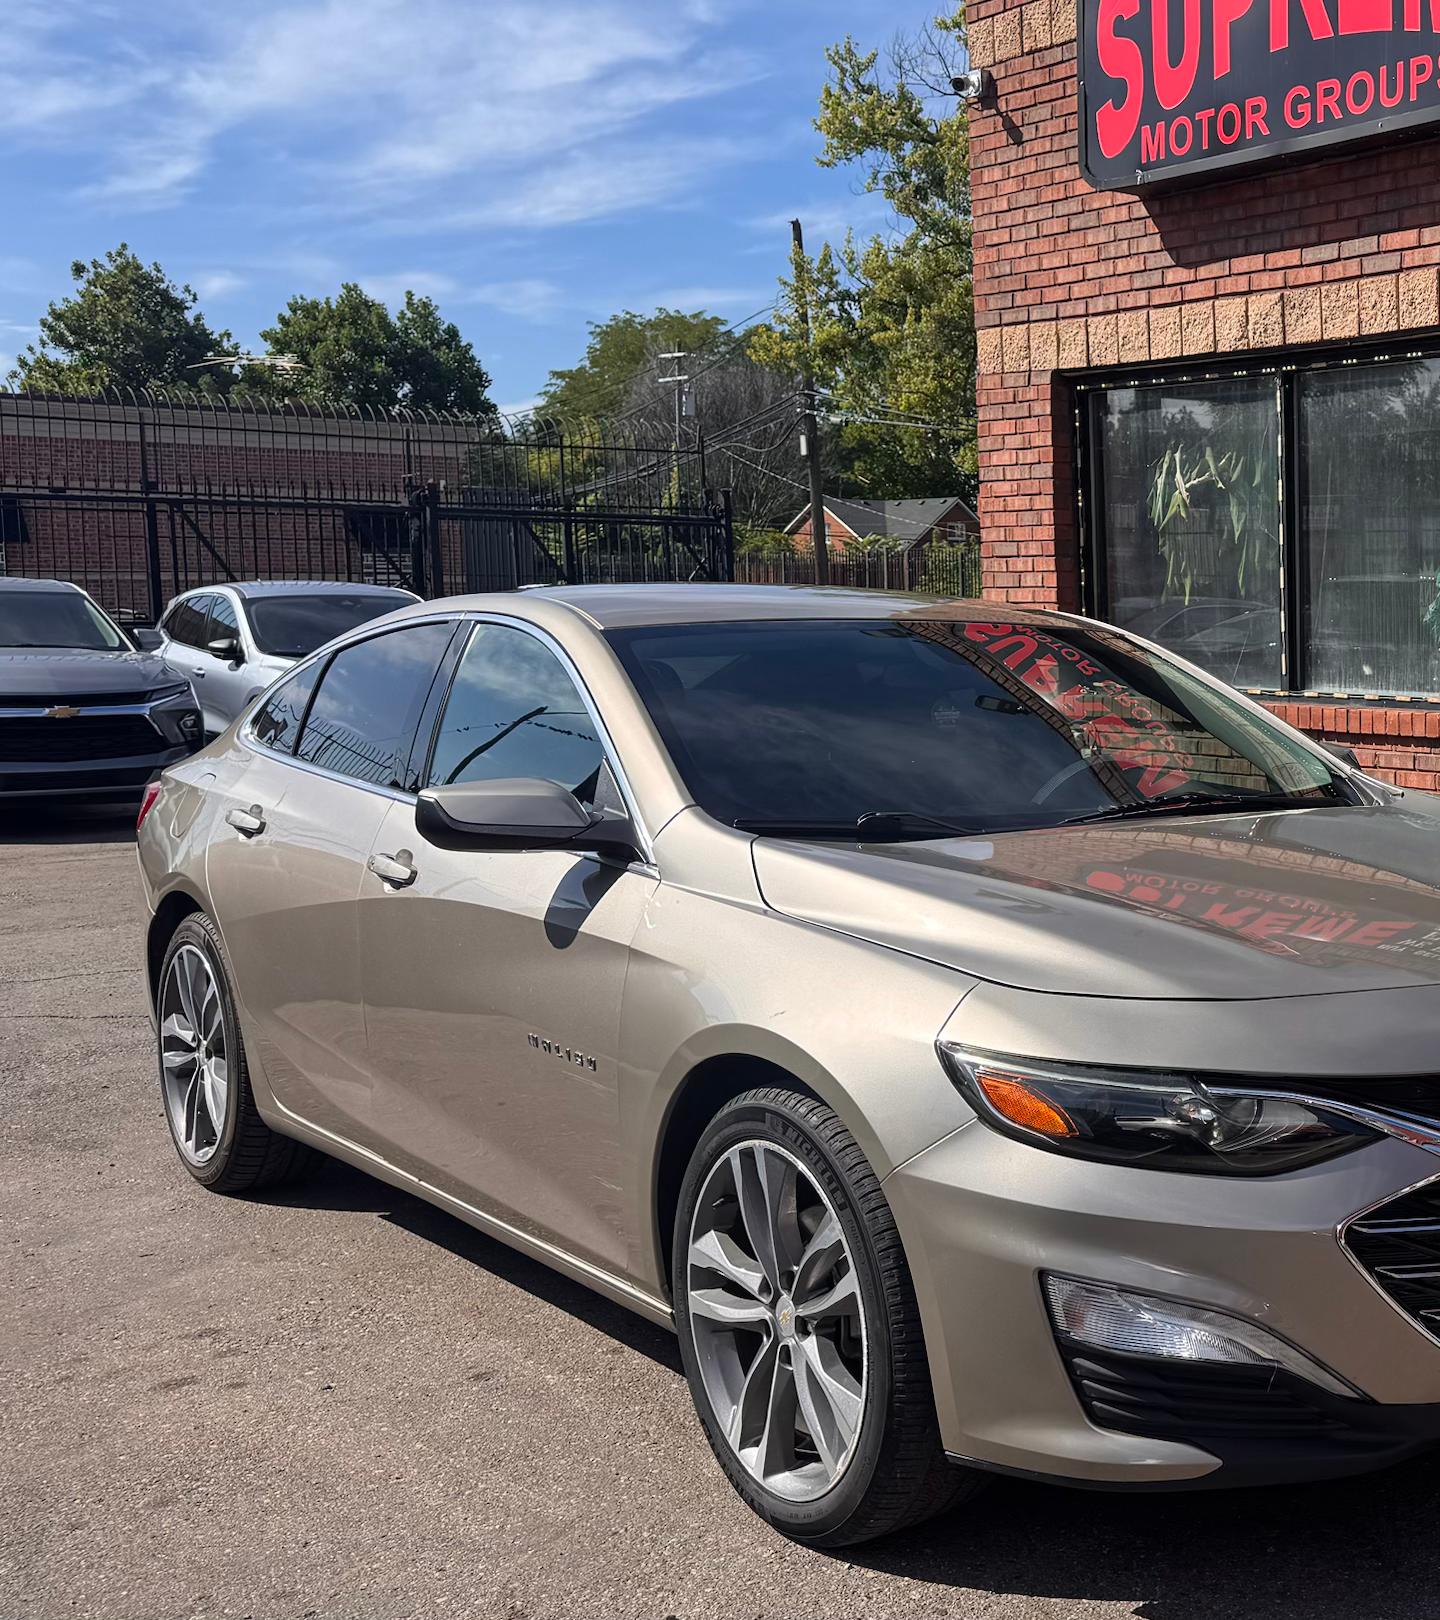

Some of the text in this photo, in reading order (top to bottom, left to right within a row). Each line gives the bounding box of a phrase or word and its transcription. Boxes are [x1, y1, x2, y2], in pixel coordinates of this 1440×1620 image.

[1141, 96, 1271, 164] MOTOR
[527, 1032, 598, 1072] MALIBU
[784, 1125, 849, 1212] MICHELIN
